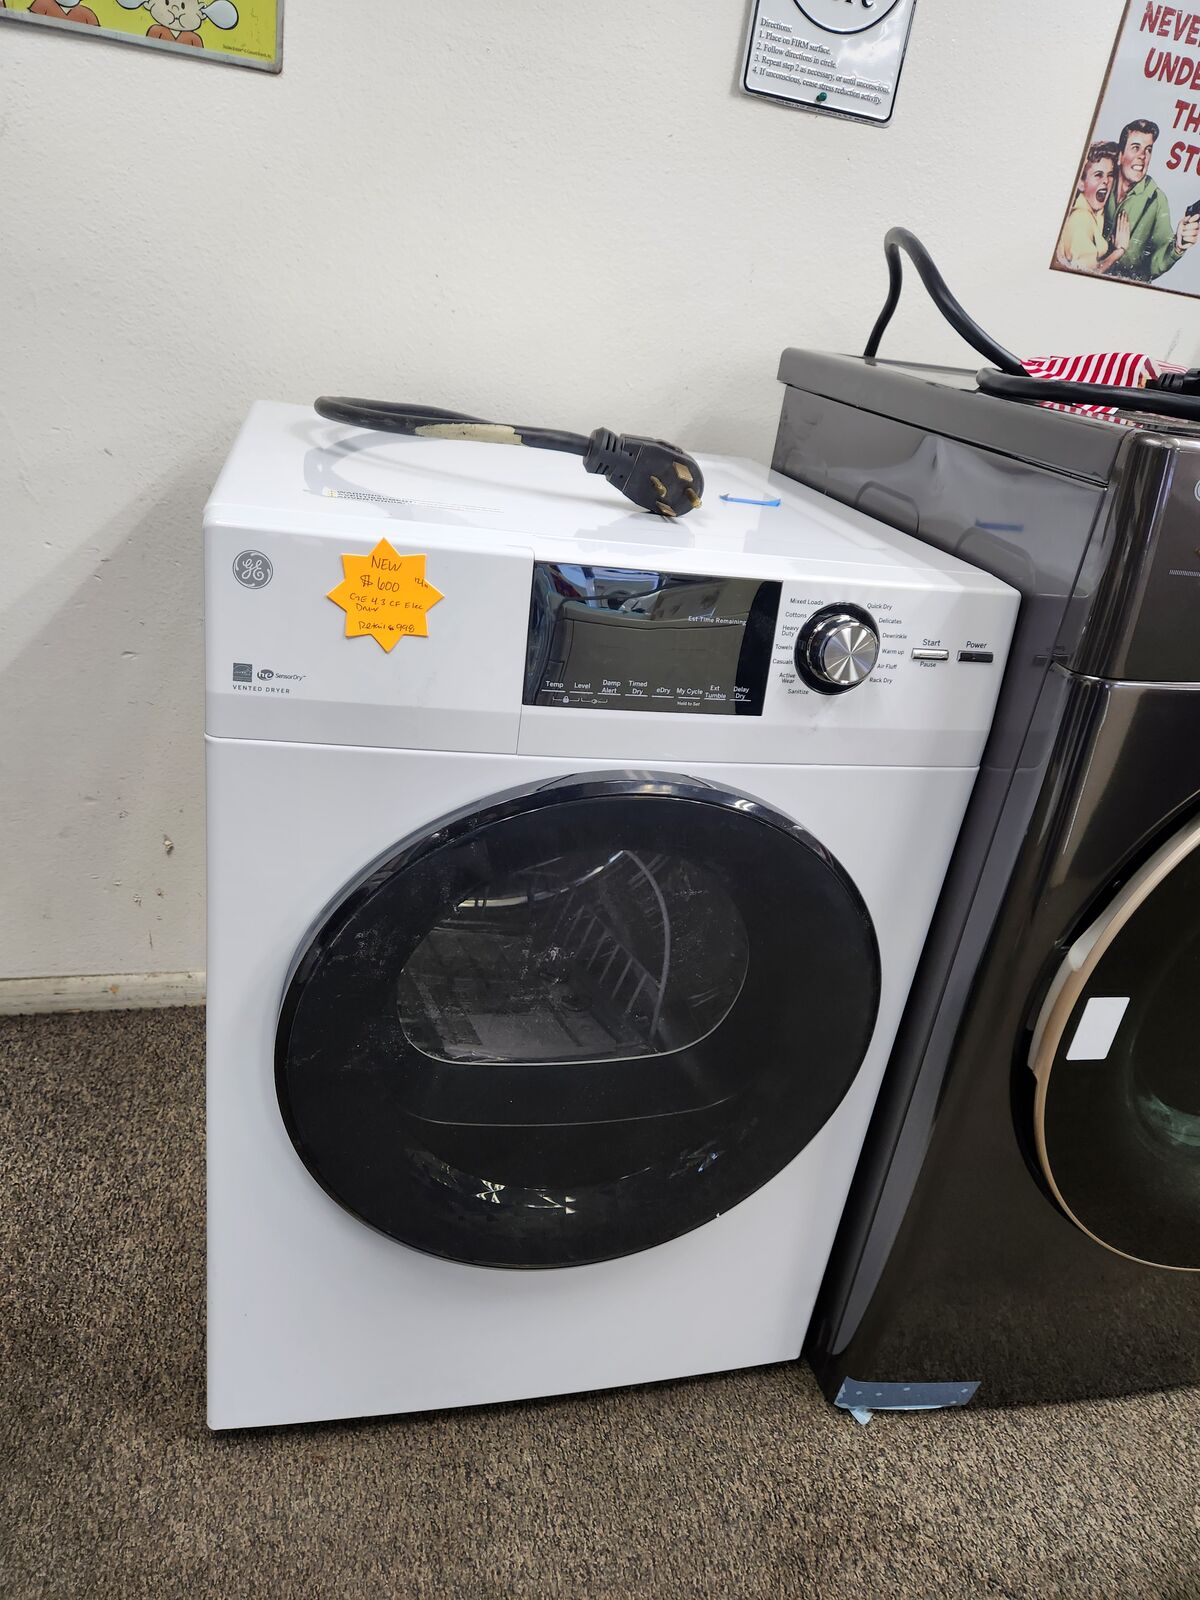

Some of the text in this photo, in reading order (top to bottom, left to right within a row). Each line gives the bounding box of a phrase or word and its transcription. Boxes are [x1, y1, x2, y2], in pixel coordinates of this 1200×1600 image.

[760, 18, 793, 33] Directions:
[1139, 1, 1200, 47] NEVE
[765, 32, 782, 42] Place
[791, 38, 809, 49] FIRM
[809, 44, 831, 55] surface.
[756, 41, 837, 69] 2. Follow directions in circle.
[754, 54, 760, 62] 3.
[761, 56, 782, 68] Repeat
[782, 61, 795, 72] step
[795, 64, 800, 72] 2
[807, 69, 835, 82] necessary,
[842, 76, 856, 86] until
[752, 66, 882, 105] 4. If unconscious, cease stress reduction activity.
[1173, 99, 1200, 134] TH
[1166, 141, 1200, 176] ST
[371, 555, 402, 571] NEW
[349, 592, 368, 603] GE
[867, 602, 882, 610] Quick
[715, 617, 747, 626] Remaining
[878, 617, 902, 625] Delicates
[922, 638, 941, 646] Start
[966, 640, 987, 648] Power
[233, 684, 263, 692] VENTED
[545, 680, 564, 689] Temp
[602, 679, 621, 687] Damp
[676, 687, 703, 696] My Cycle
[733, 686, 750, 694] Delay
